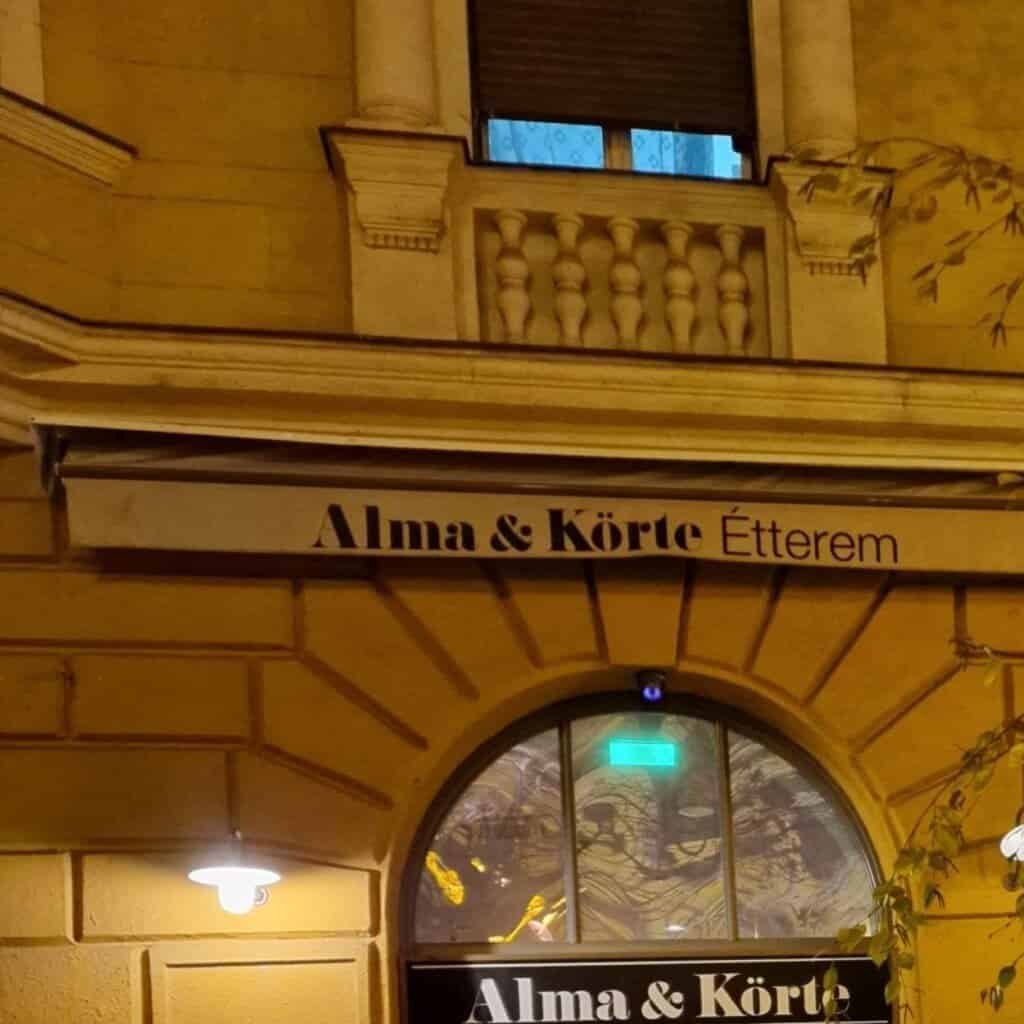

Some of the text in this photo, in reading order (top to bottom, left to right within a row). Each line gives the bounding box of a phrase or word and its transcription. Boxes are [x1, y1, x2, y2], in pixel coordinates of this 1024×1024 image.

[312, 503, 899, 564] Alma & Körte Étterem
[464, 971, 851, 1024] Alma & Körte
